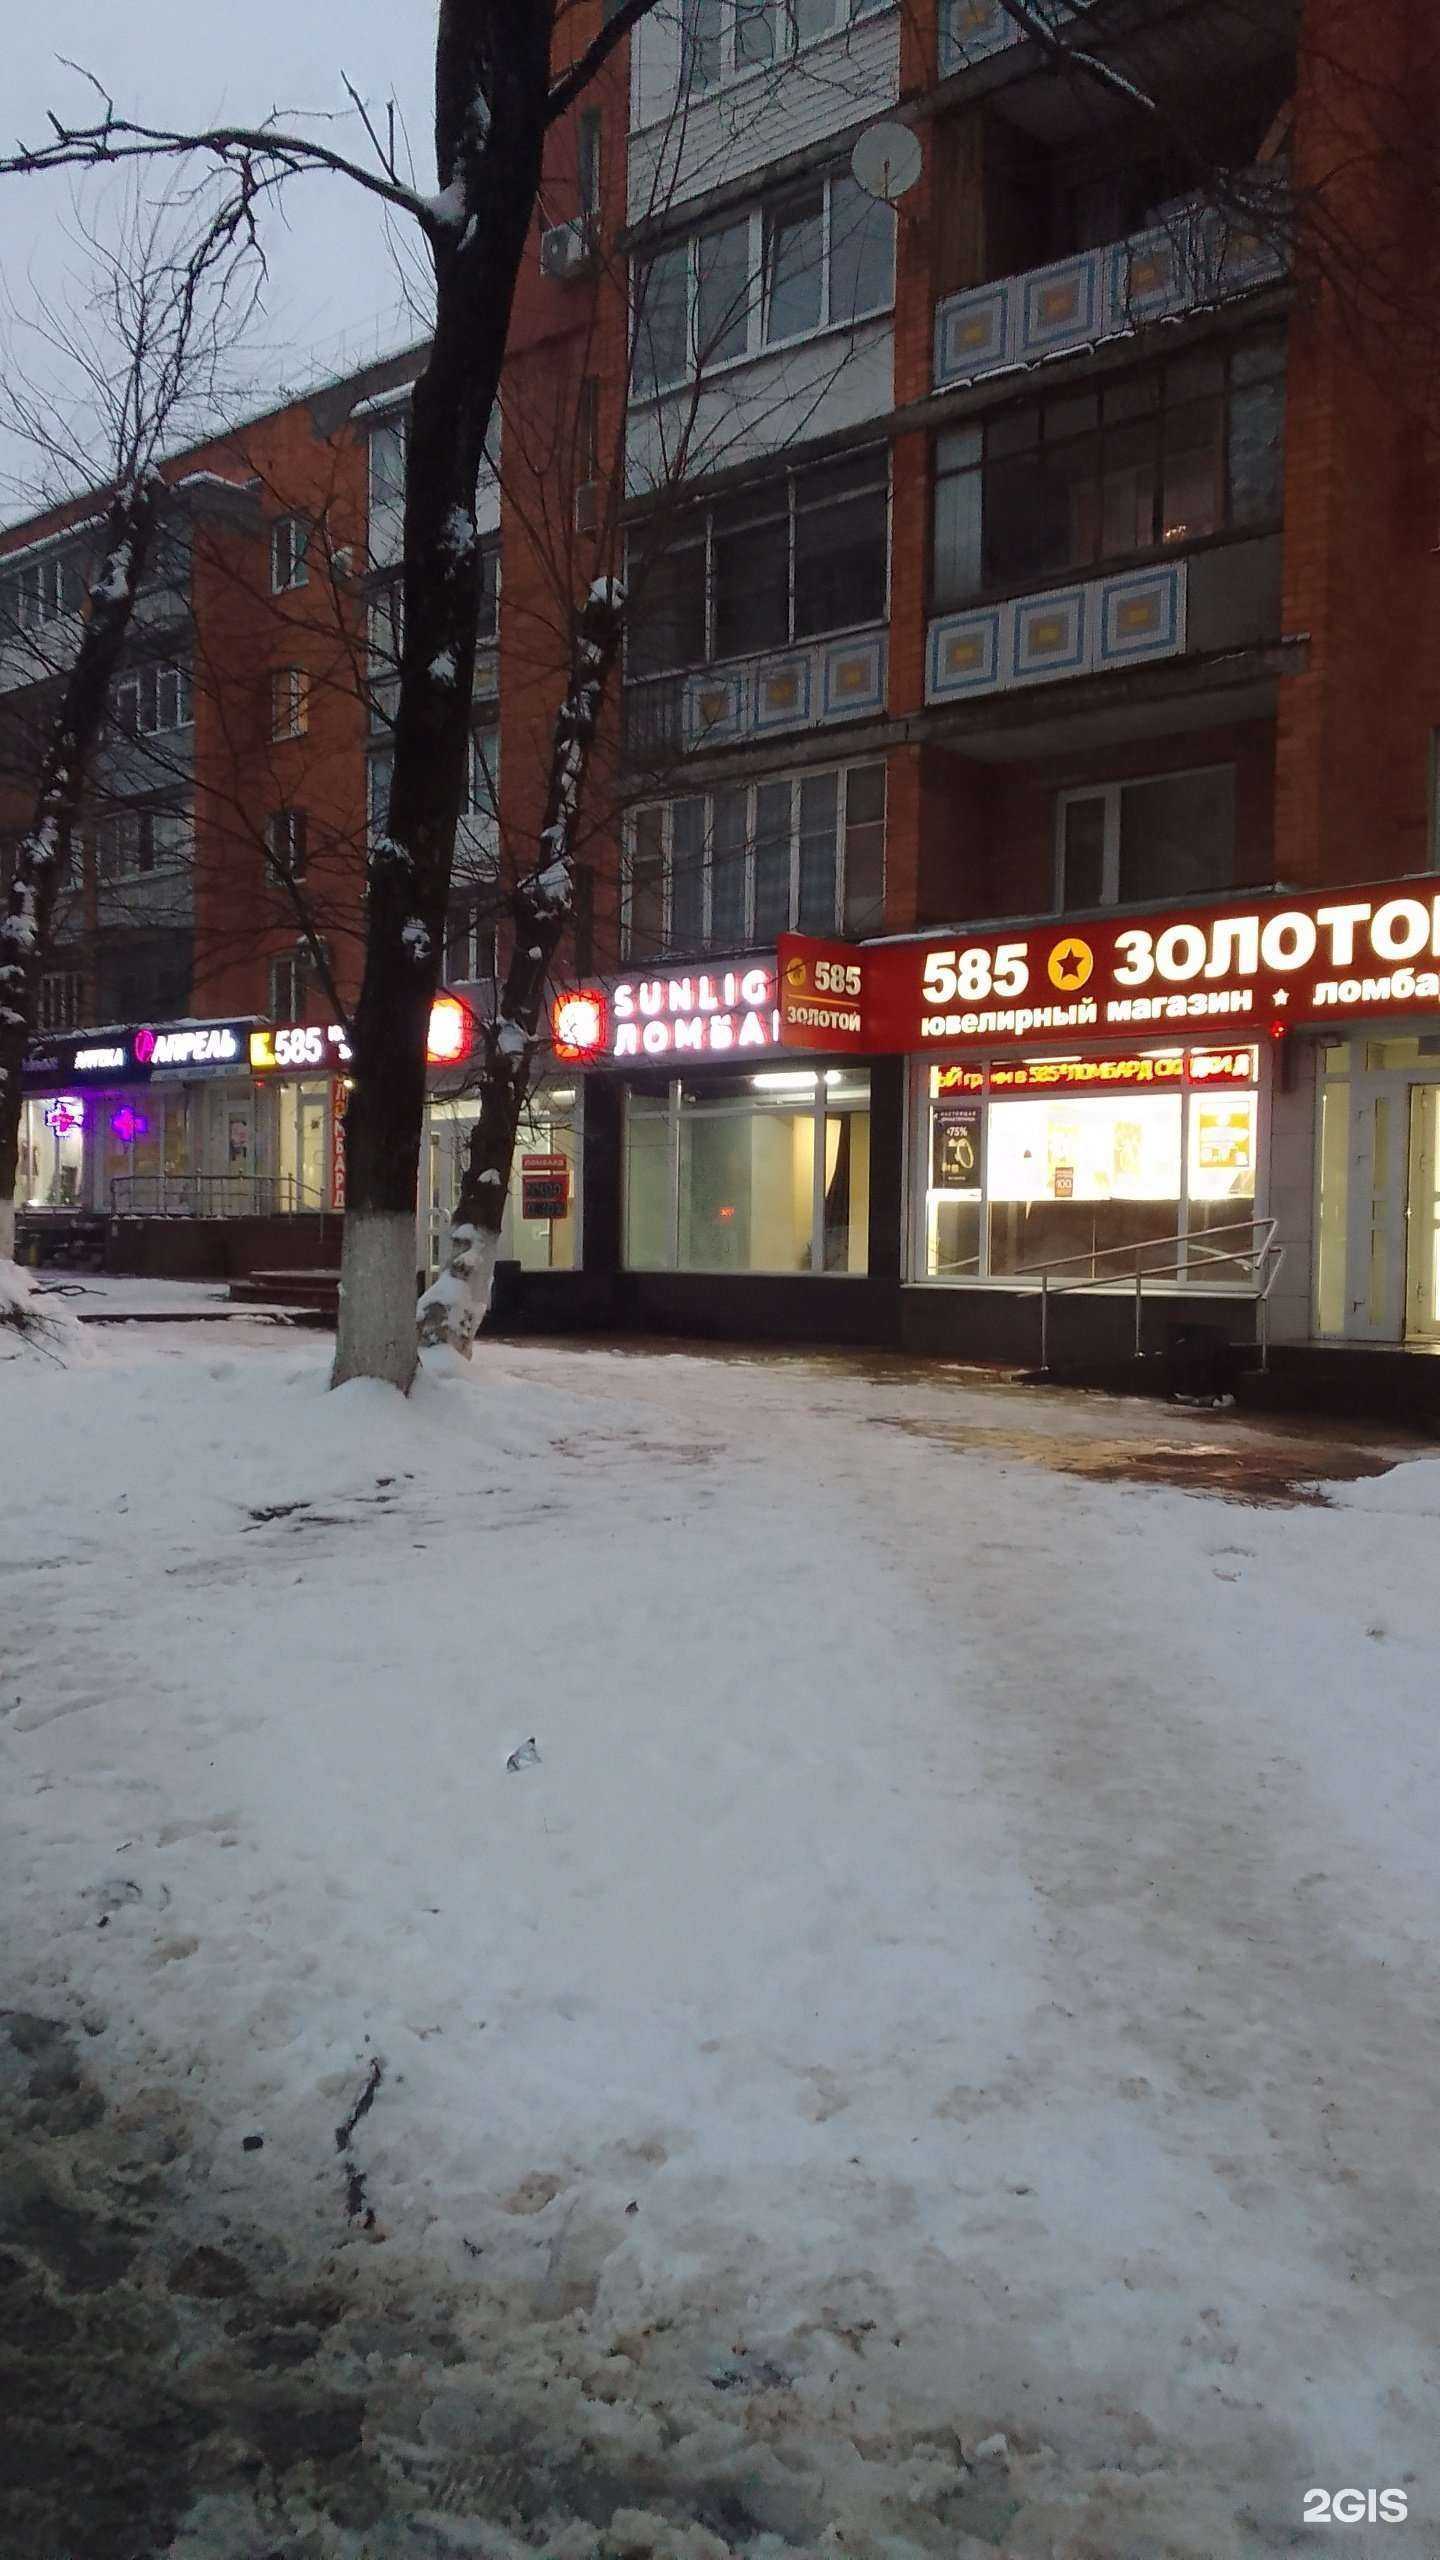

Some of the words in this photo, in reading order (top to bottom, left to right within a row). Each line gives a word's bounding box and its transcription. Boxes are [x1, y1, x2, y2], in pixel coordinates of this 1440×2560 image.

[614, 969, 768, 1017] SUNLIG
[815, 961, 861, 995] 585
[922, 943, 1029, 1003] 585
[787, 1006, 861, 1032] ЗОЛОТОЙ
[921, 997, 1098, 1036] ювелирный
[1107, 990, 1253, 1022] магазин
[1312, 967, 1440, 1006] ломба
[151, 1029, 236, 1063] АПРЕЛЬ
[275, 1027, 322, 1065] 585
[614, 1009, 780, 1056] ЛОМБА
